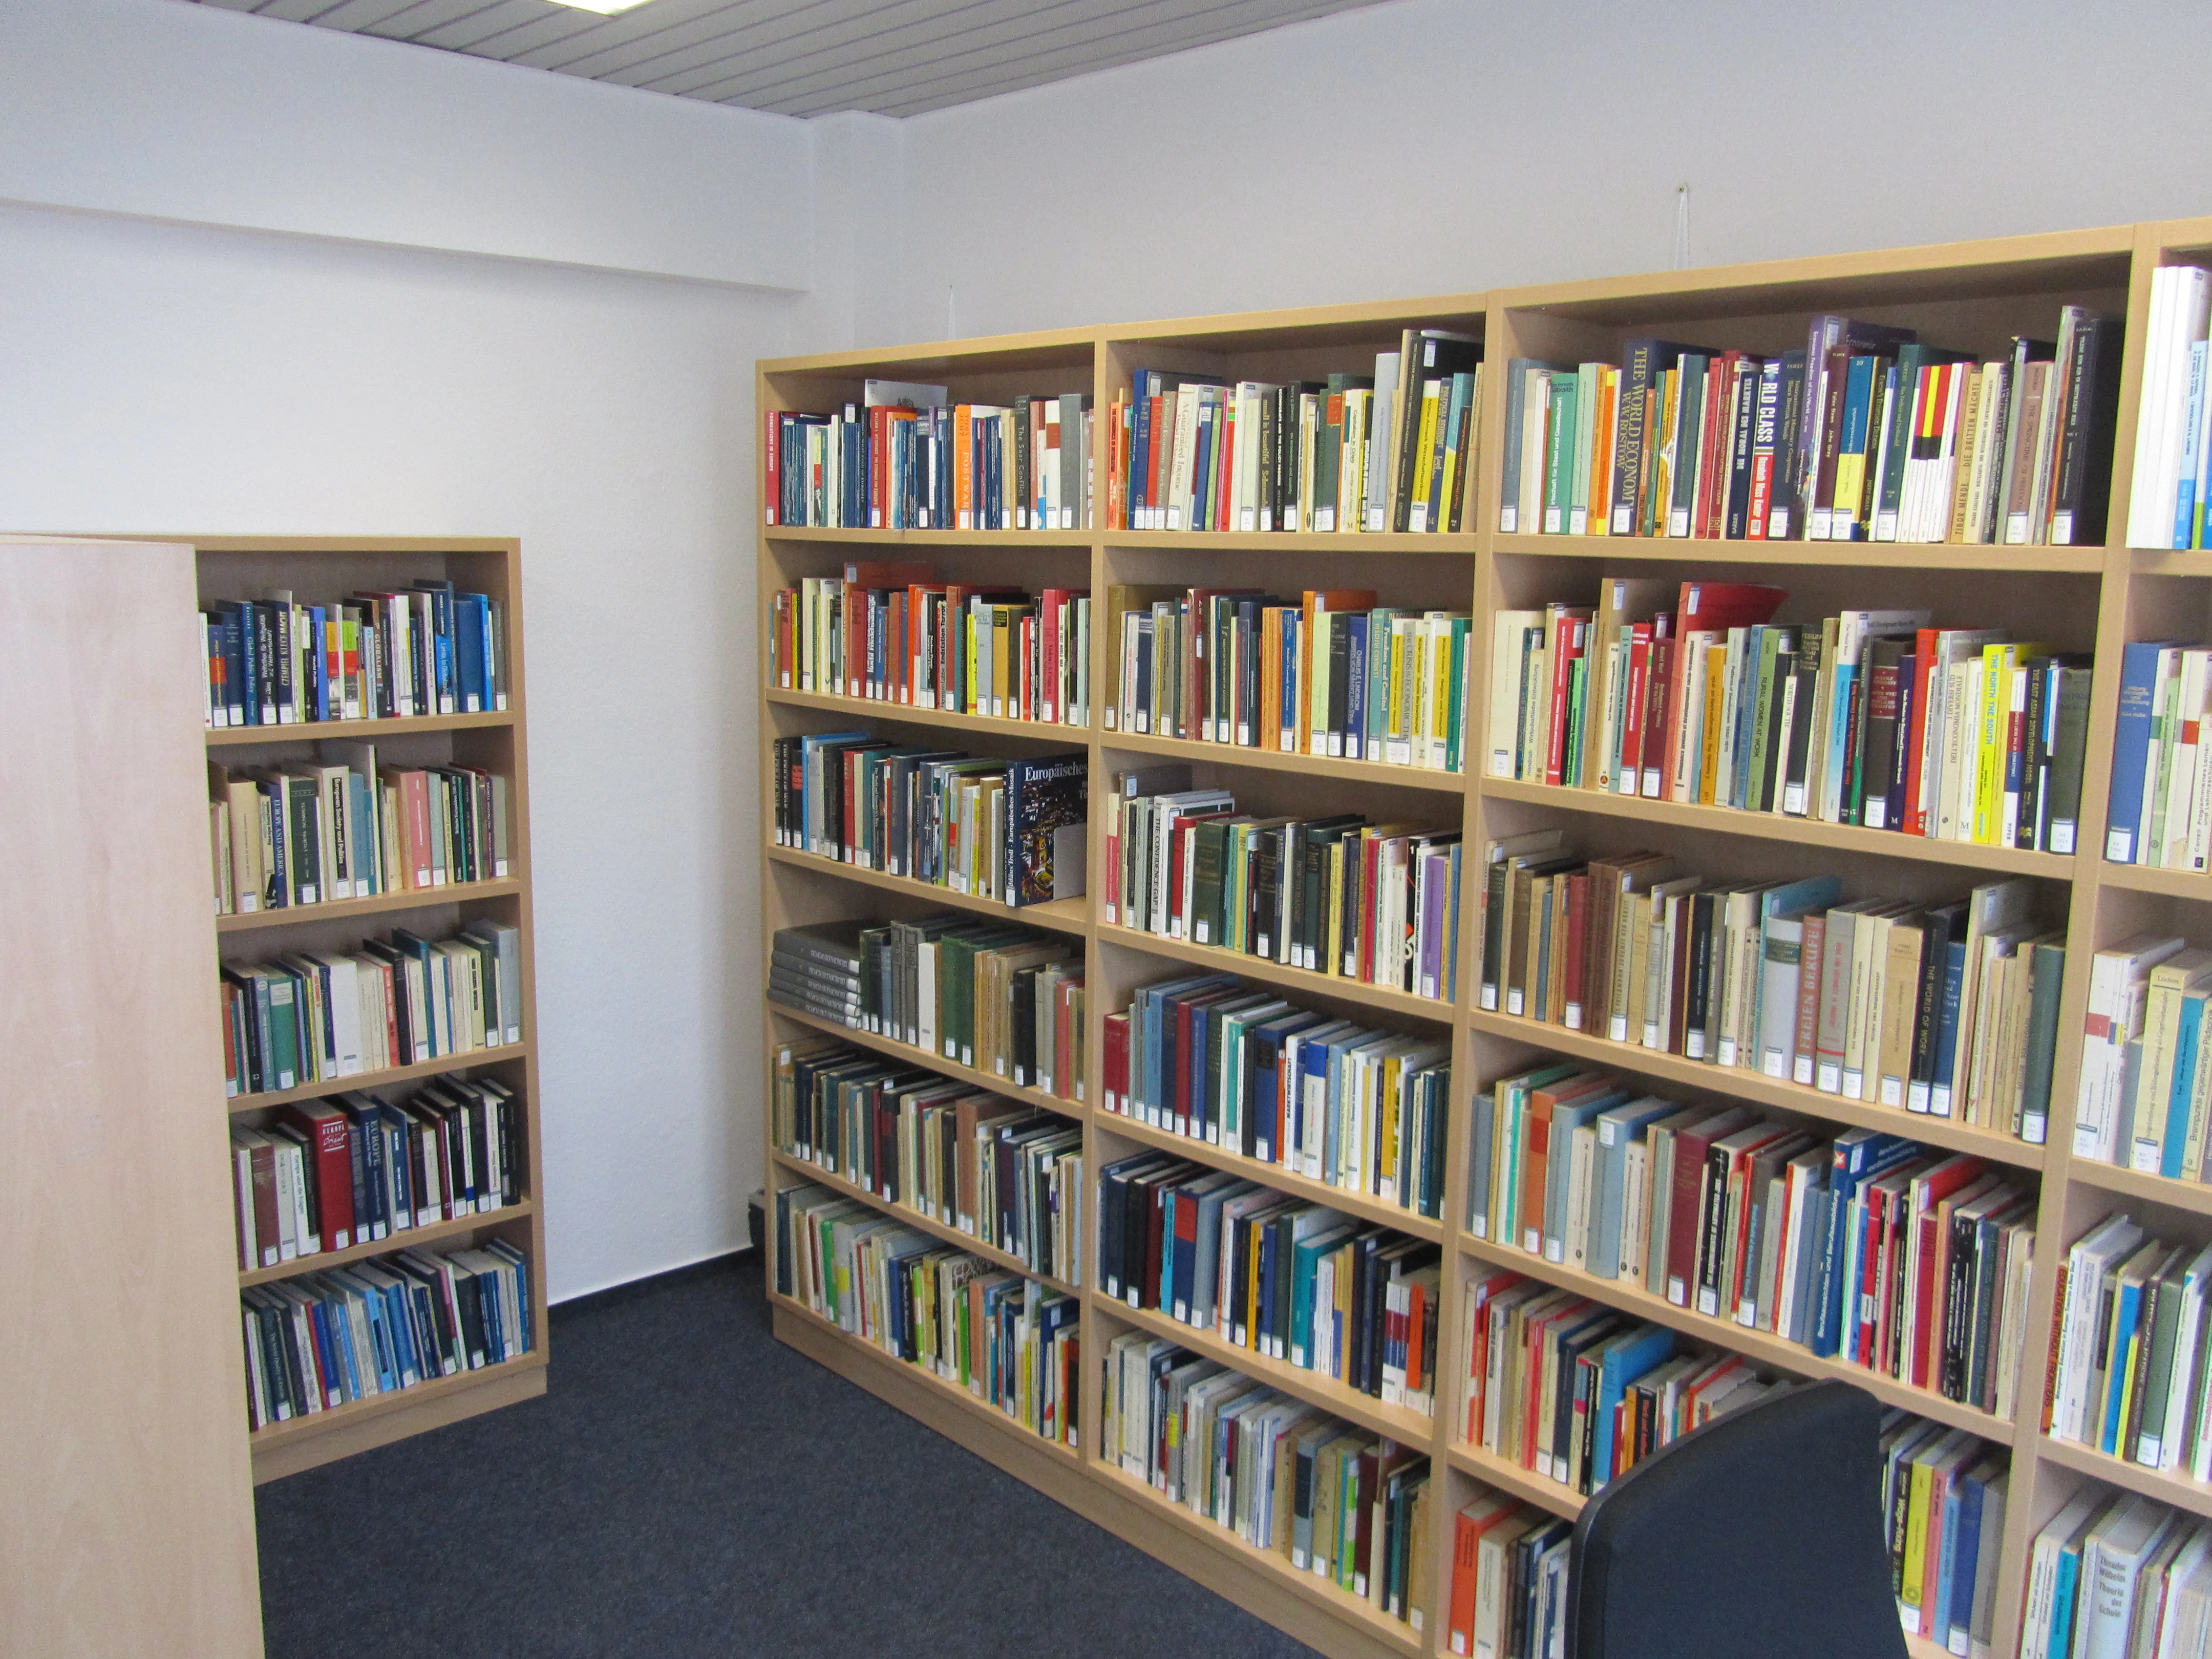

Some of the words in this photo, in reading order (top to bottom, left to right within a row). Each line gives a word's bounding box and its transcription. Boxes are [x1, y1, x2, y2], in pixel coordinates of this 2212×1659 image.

[1632, 347, 1648, 380] THE
[1627, 382, 1646, 437] WORLD
[1741, 377, 1752, 413] MARKTES
[1792, 380, 1800, 417] International
[1968, 381, 1981, 410] MÄCHTE
[1178, 410, 1189, 458] Guaranteed
[1423, 399, 1432, 441] Müller-Armack
[1758, 406, 1775, 443] CLASS
[1964, 417, 1976, 450] DRITTEN
[1737, 429, 1747, 455] MORAL
[1175, 461, 1184, 491] Income
[1417, 443, 1428, 501] Wirtschaftsordnung
[1621, 440, 1640, 504] ECONOM
[1736, 458, 1745, 470] DIE
[1963, 455, 1971, 467] DIE
[1957, 482, 1968, 508] MENDE
[1954, 512, 1965, 535] TIBOR
[1954, 675, 1962, 709] MONDIALE
[1989, 672, 1997, 697] NORTH
[1756, 700, 1764, 726] WOMEN
[1950, 711, 1960, 763] DELL'ECONOMIA
[1985, 718, 1994, 745] SOUTH
[2026, 720, 2035, 761] DEVELOPMENT
[1025, 760, 1087, 782] Europäisches
[333, 778, 342, 807] European
[2197, 769, 2207, 824] Programmiertes
[1804, 930, 1819, 989] BERUFE
[1927, 965, 1935, 980] THE
[1923, 982, 1933, 1012] WORLD
[1800, 995, 1814, 1048] FREIEN
[1922, 1015, 1929, 1027] OF
[2202, 1008, 2212, 1045] Pädagogik
[1919, 1029, 1928, 1055] WORK
[2196, 1045, 2210, 1095] gegenwärtiger
[2189, 1097, 2202, 1141] Brennpunkte
[369, 1119, 382, 1165] EUROPE
[1817, 1273, 1831, 1337] Berufsaussichten
[1826, 1189, 1840, 1254] Berufsausbildung
[2054, 1270, 2066, 1316] EDUCATION
[2050, 1321, 2060, 1353] WITHOUT
[2044, 1362, 2055, 1407] FRONTIERS
[2099, 1554, 2126, 1571] Theodor
[2099, 1566, 2125, 1582] Wilhelm
[2099, 1581, 2124, 1597] Theorie
[2098, 1605, 2121, 1618] Schule
